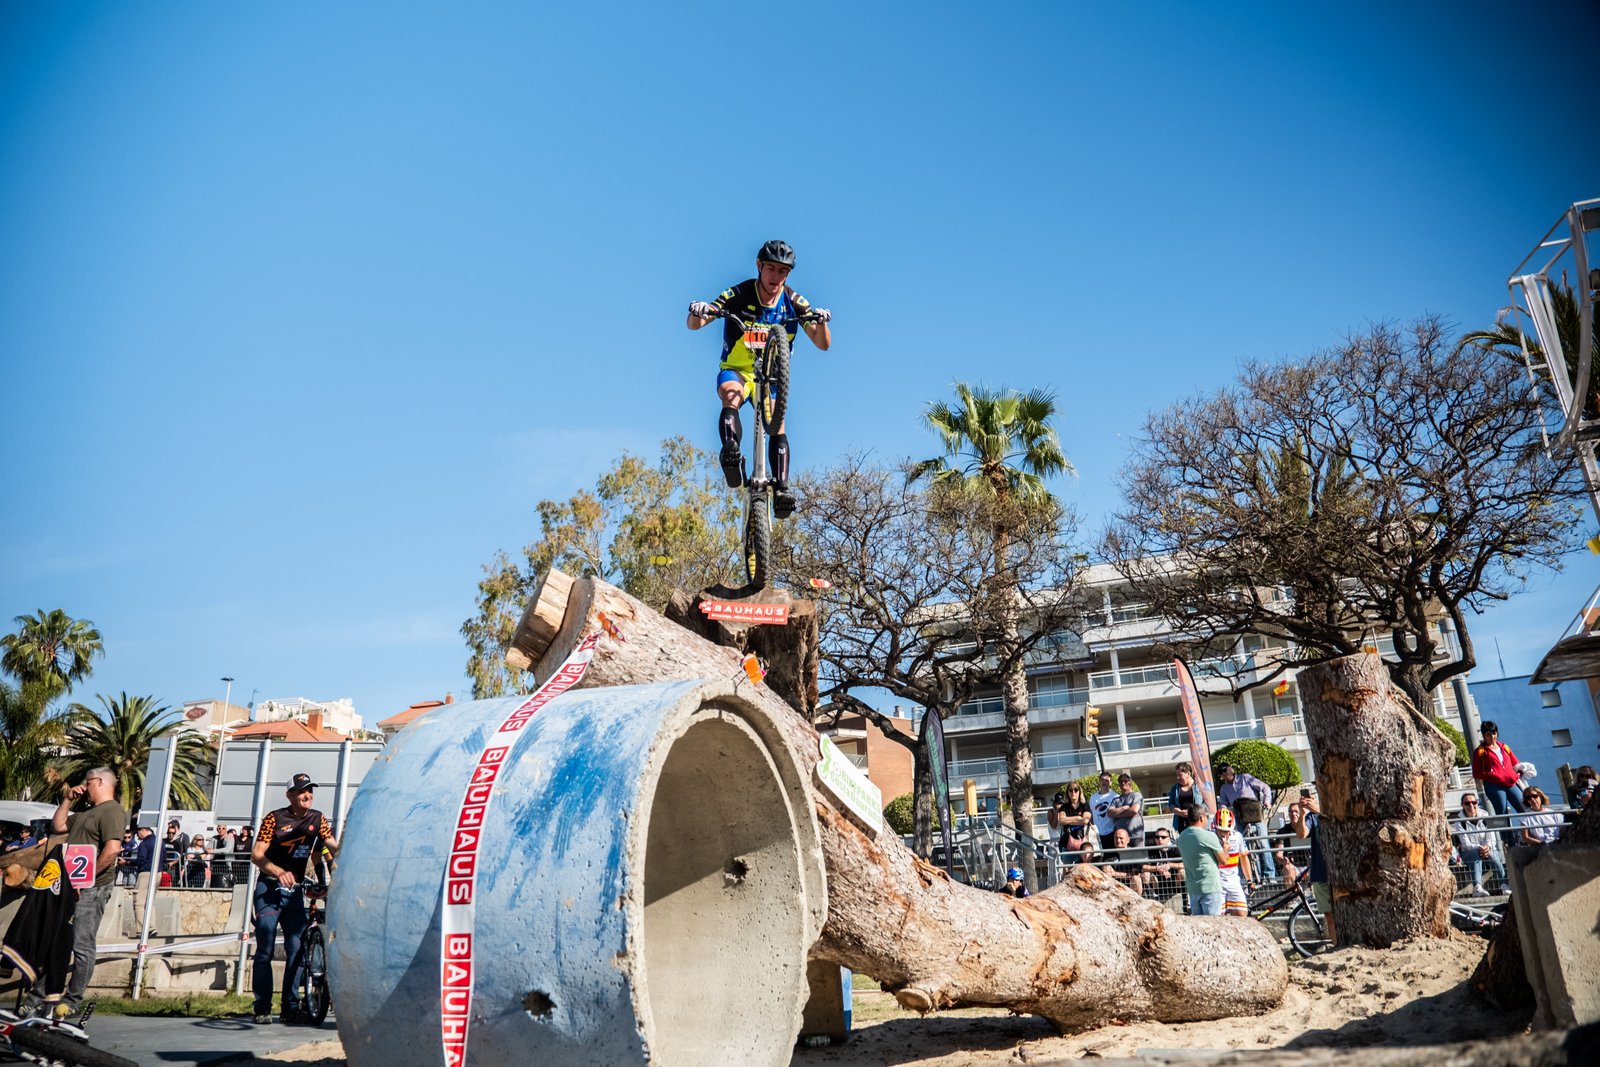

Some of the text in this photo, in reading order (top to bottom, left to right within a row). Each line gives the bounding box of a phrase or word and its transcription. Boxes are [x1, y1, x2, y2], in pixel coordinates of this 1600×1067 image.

[714, 603, 785, 616] BAUHAUS
[504, 664, 583, 731] BAUHAUS
[453, 748, 502, 902] BAUHAUS
[70, 855, 89, 879] 2
